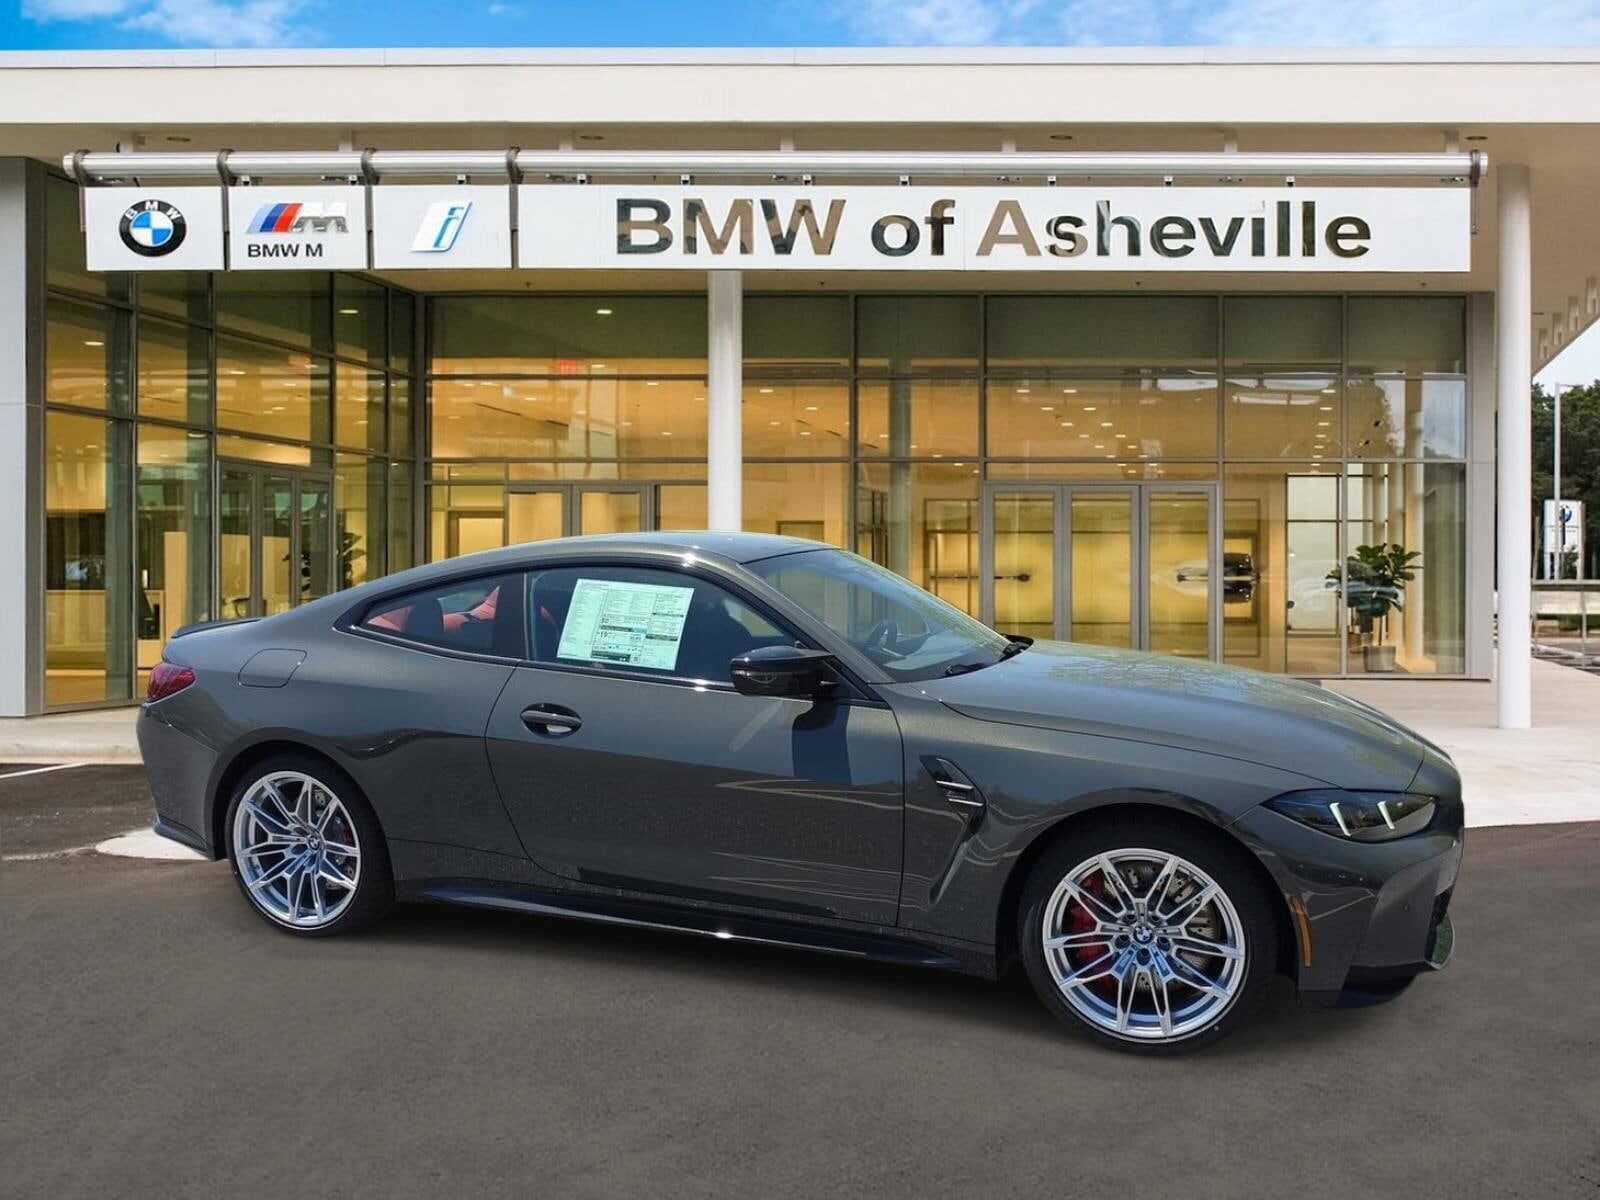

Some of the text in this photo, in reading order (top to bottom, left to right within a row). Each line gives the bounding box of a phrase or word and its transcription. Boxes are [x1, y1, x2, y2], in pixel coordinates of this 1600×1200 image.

[125, 201, 182, 220] BMW
[617, 198, 1372, 258] BMW of Asheville
[247, 243, 323, 258] BMW M
